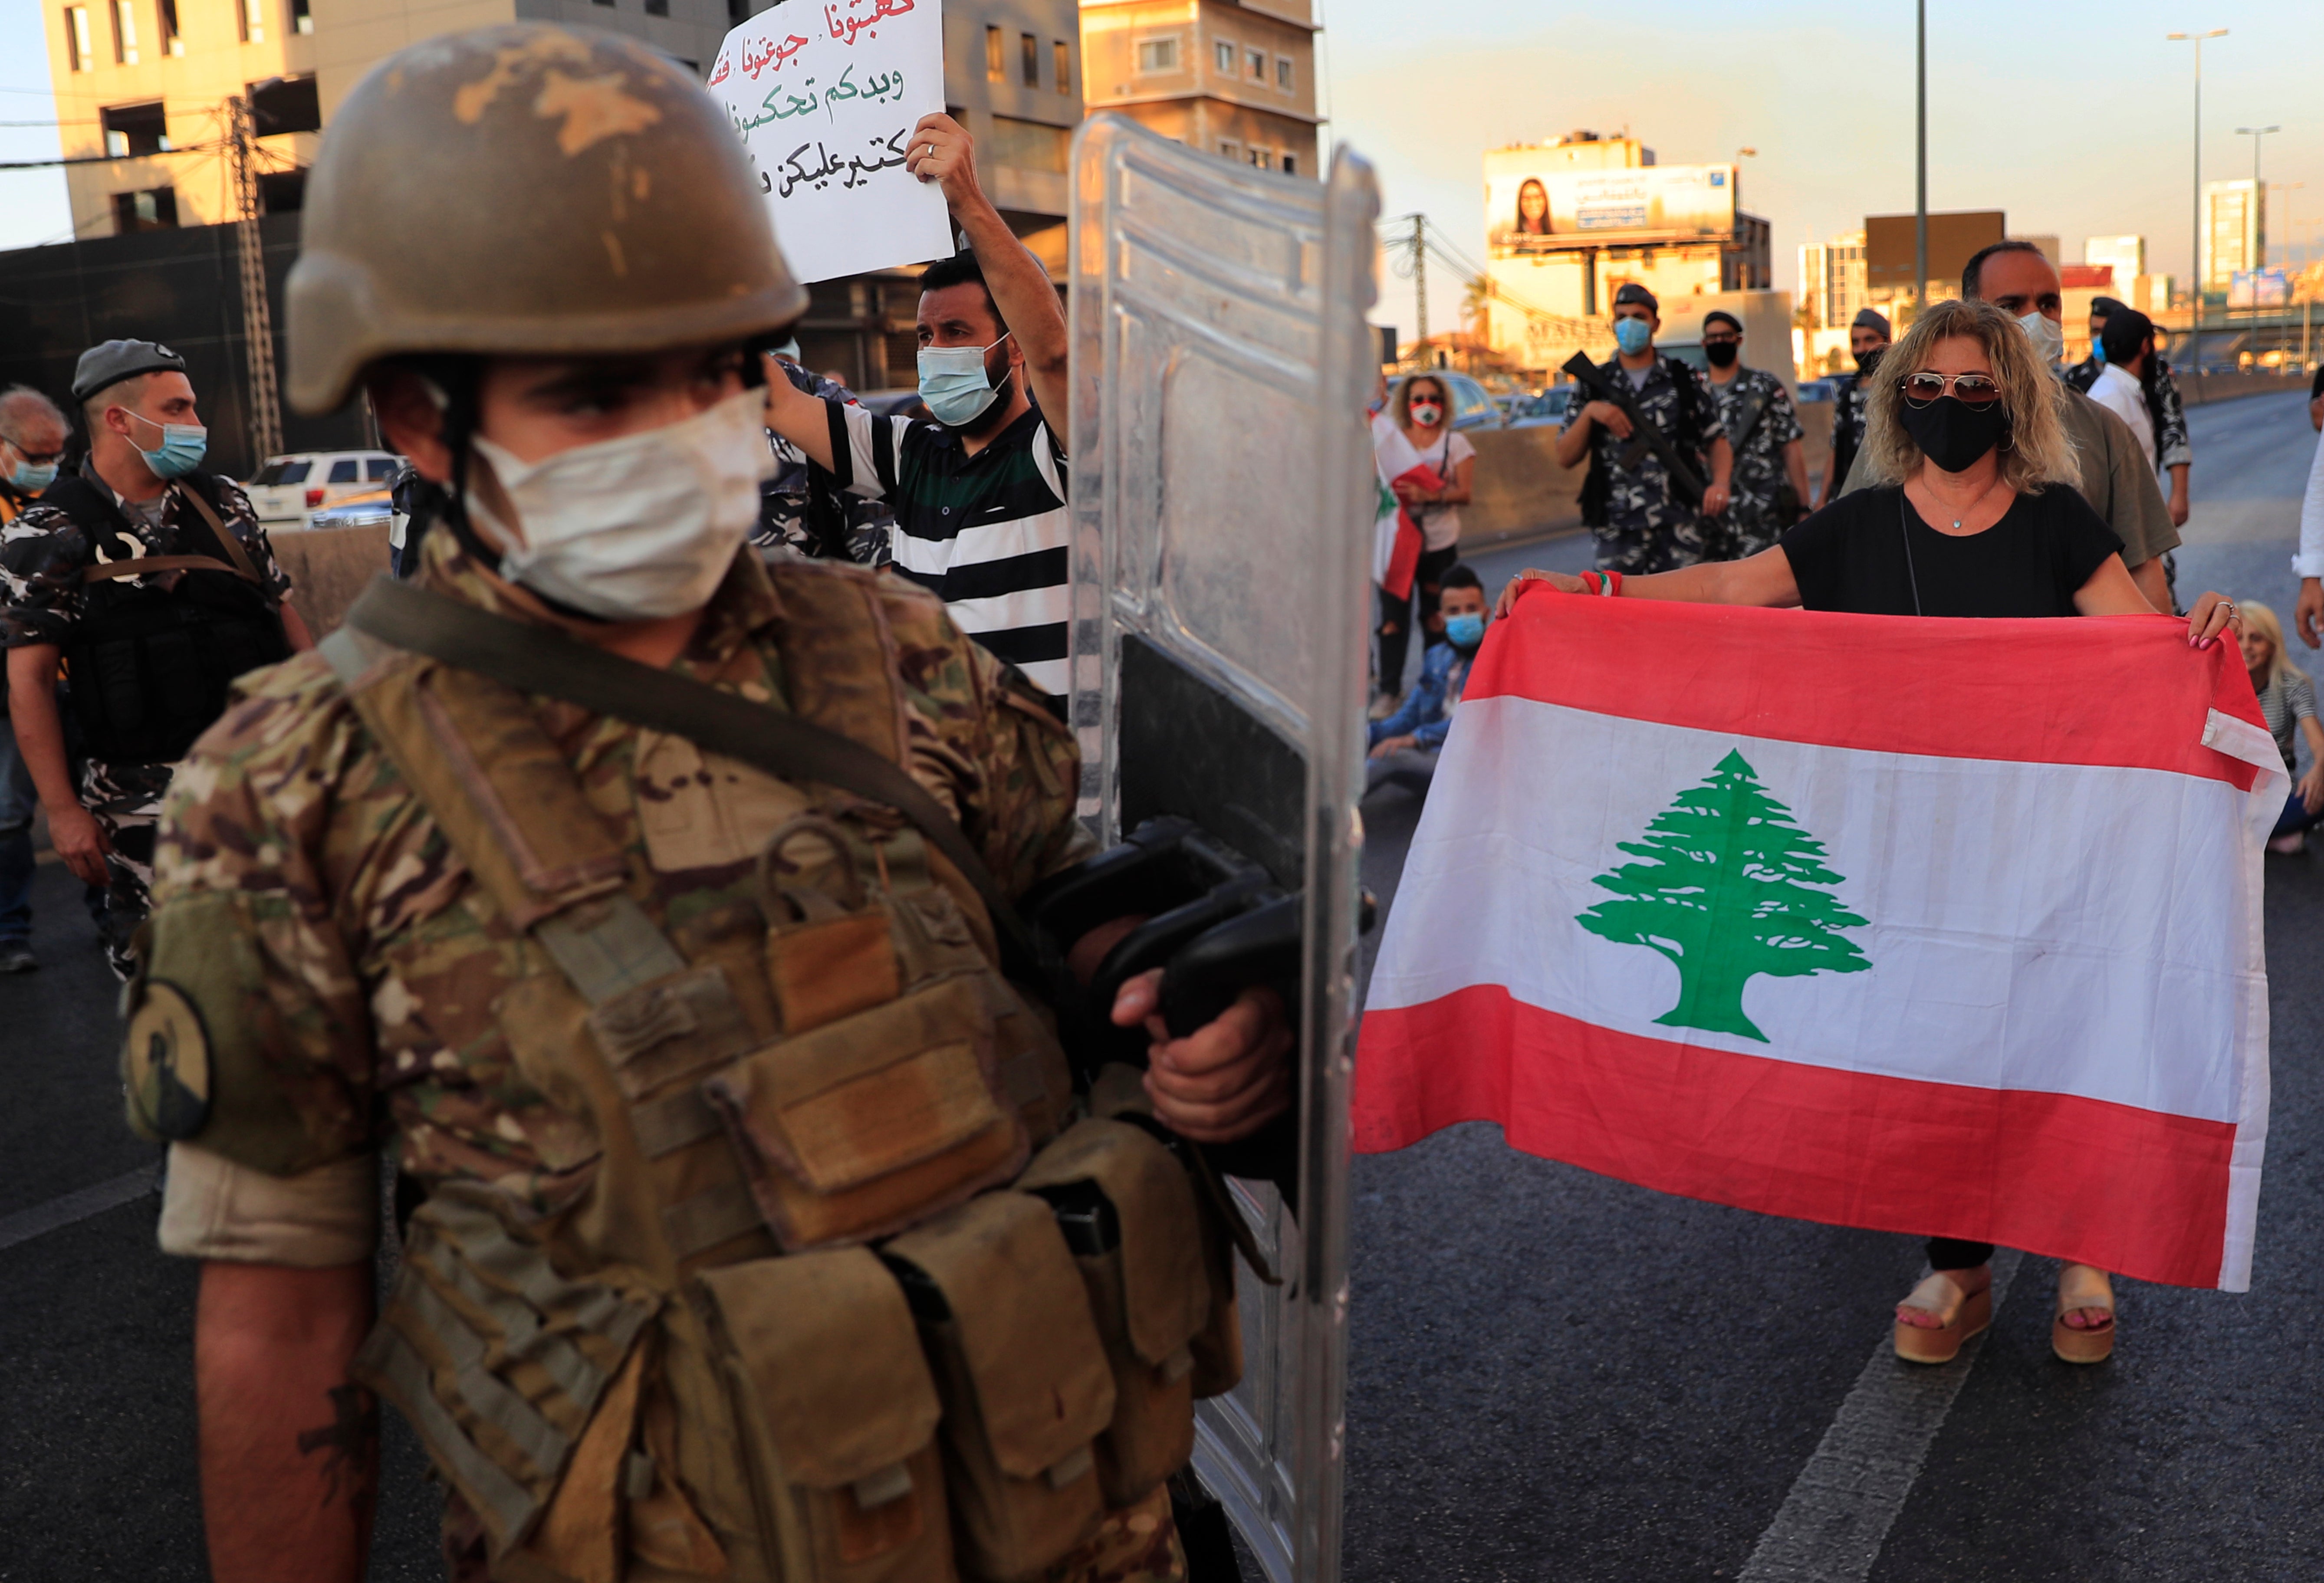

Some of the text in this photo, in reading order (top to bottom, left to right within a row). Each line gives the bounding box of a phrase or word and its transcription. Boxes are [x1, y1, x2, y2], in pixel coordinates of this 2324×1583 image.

[825, 62, 904, 125] وبدكم
[779, 141, 845, 198] عليكن
[843, 128, 907, 189] كتير
